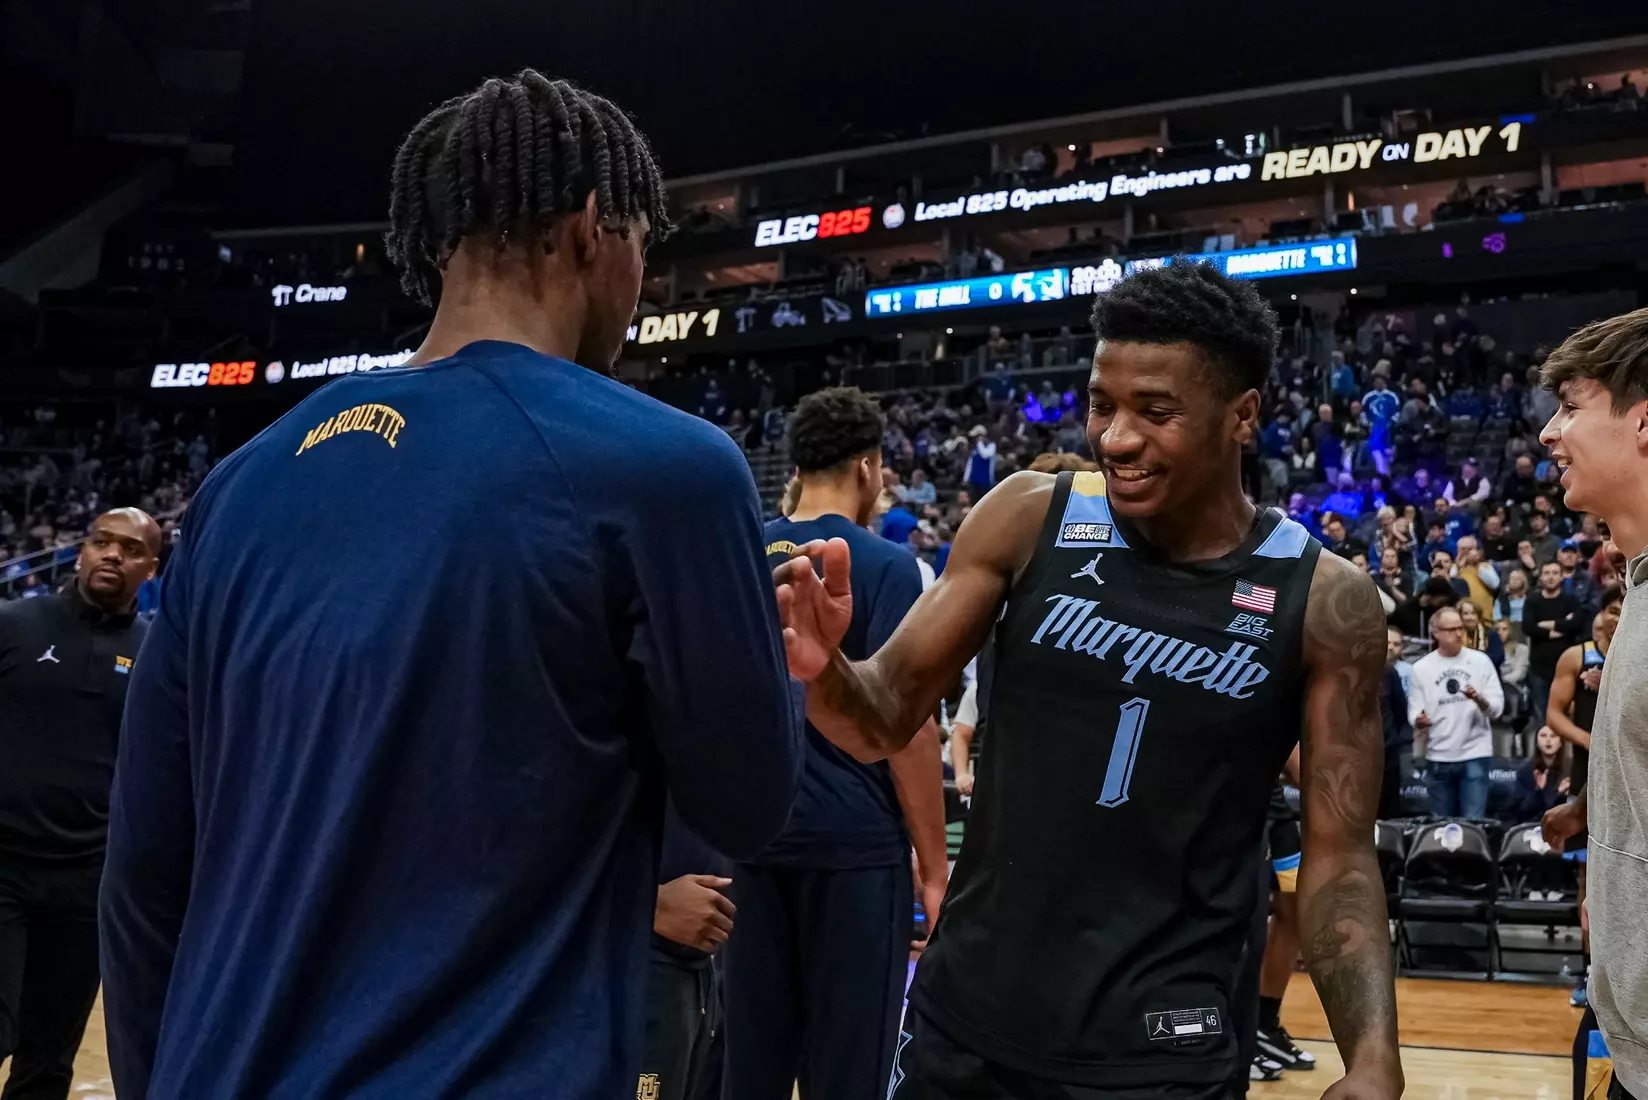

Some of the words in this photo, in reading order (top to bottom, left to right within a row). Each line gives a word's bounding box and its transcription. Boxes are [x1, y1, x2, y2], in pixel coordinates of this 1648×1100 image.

[914, 197, 965, 221] Local
[966, 191, 1009, 214] 825
[1010, 180, 1108, 212] Operating
[1110, 169, 1212, 197] Engineers
[1214, 164, 1251, 182] are
[1261, 139, 1382, 181] READY
[1382, 142, 1410, 162] ON
[1414, 125, 1492, 163] DAY
[1499, 122, 1522, 152] 1
[755, 206, 871, 247] ELEC825
[295, 284, 347, 303] Crane
[638, 311, 698, 344] DAY
[701, 308, 720, 336] 1
[151, 361, 256, 388] ELEC825
[291, 358, 328, 379] Local
[327, 354, 358, 375] 825
[295, 403, 405, 456] MARQUETTE
[1064, 532, 1110, 540] CHANGE
[1227, 621, 1274, 637] EAST
[1234, 612, 1267, 626] BIG
[1030, 593, 1270, 700] Marquette
[1095, 697, 1150, 808] 1
[1206, 1014, 1217, 1026] 46
